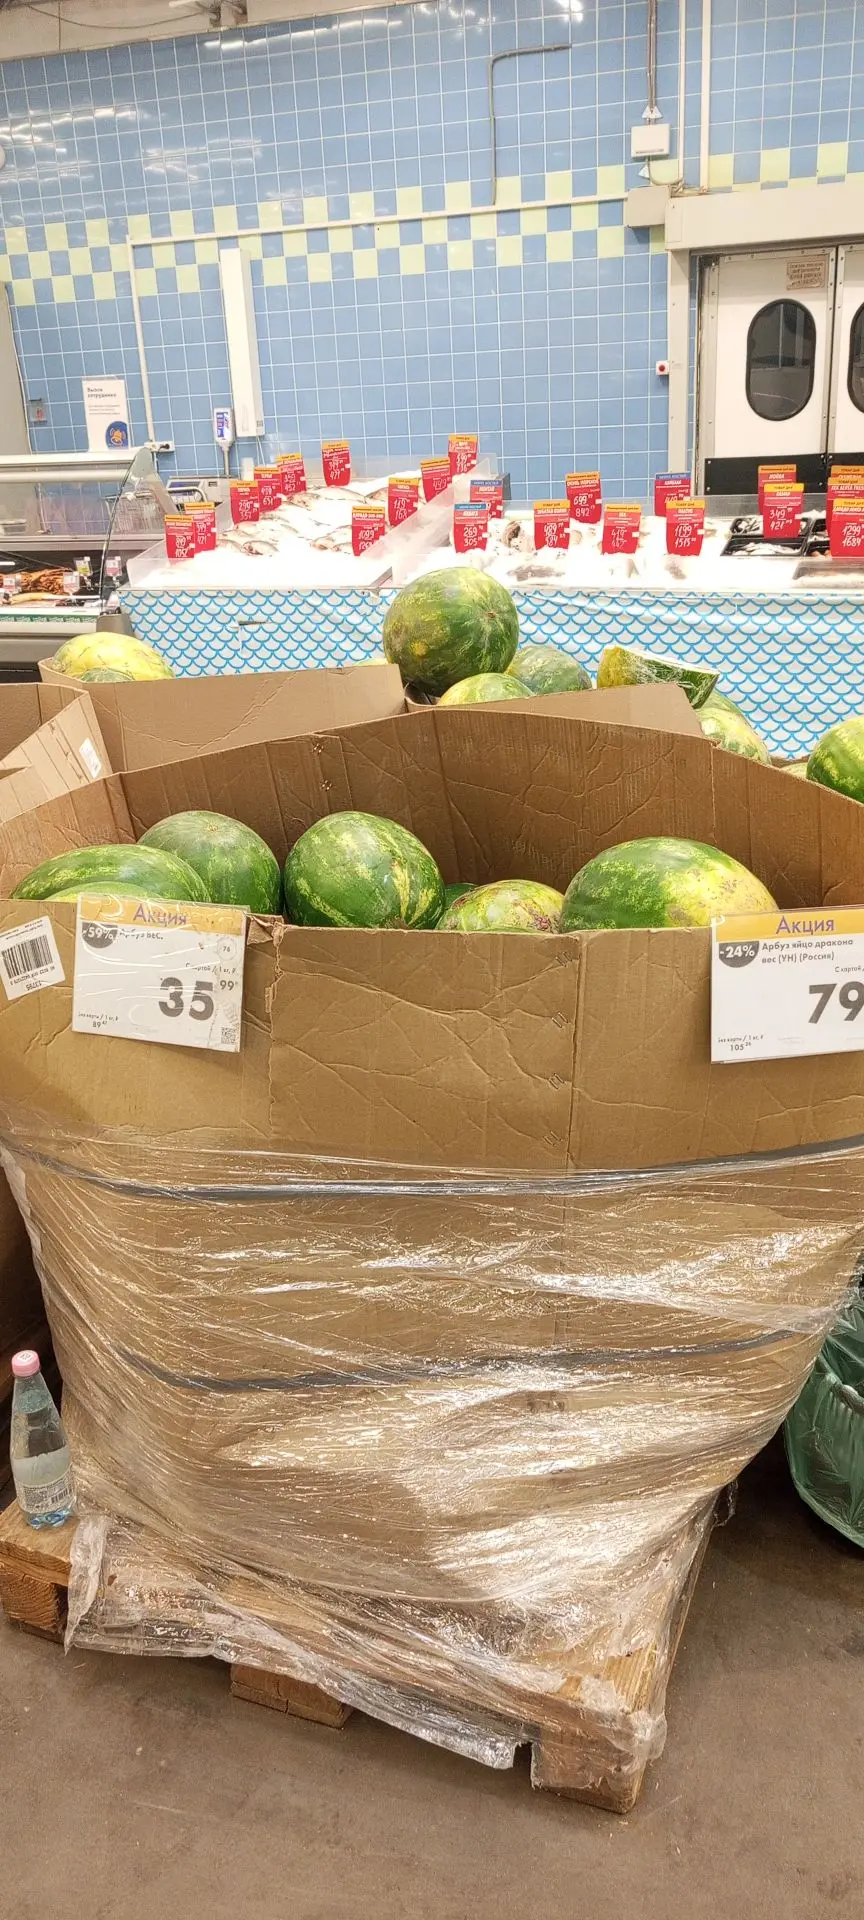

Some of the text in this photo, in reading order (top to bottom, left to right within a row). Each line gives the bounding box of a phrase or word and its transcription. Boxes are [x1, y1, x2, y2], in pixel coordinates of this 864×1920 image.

[576, 508, 590, 517] 842
[770, 510, 785, 519] 349
[463, 527, 477, 537] 269
[464, 538, 477, 546] 305
[133, 902, 187, 927] Акция
[776, 915, 835, 935] Акция
[82, 926, 114, 941] -59%
[762, 939, 853, 951] Арбуз яйцо дракона
[720, 945, 755, 958] -24%
[778, 954, 797, 964] (УН)
[800, 952, 835, 963] (Россия)
[158, 976, 235, 1021] 35 99
[808, 981, 864, 1024] 79
